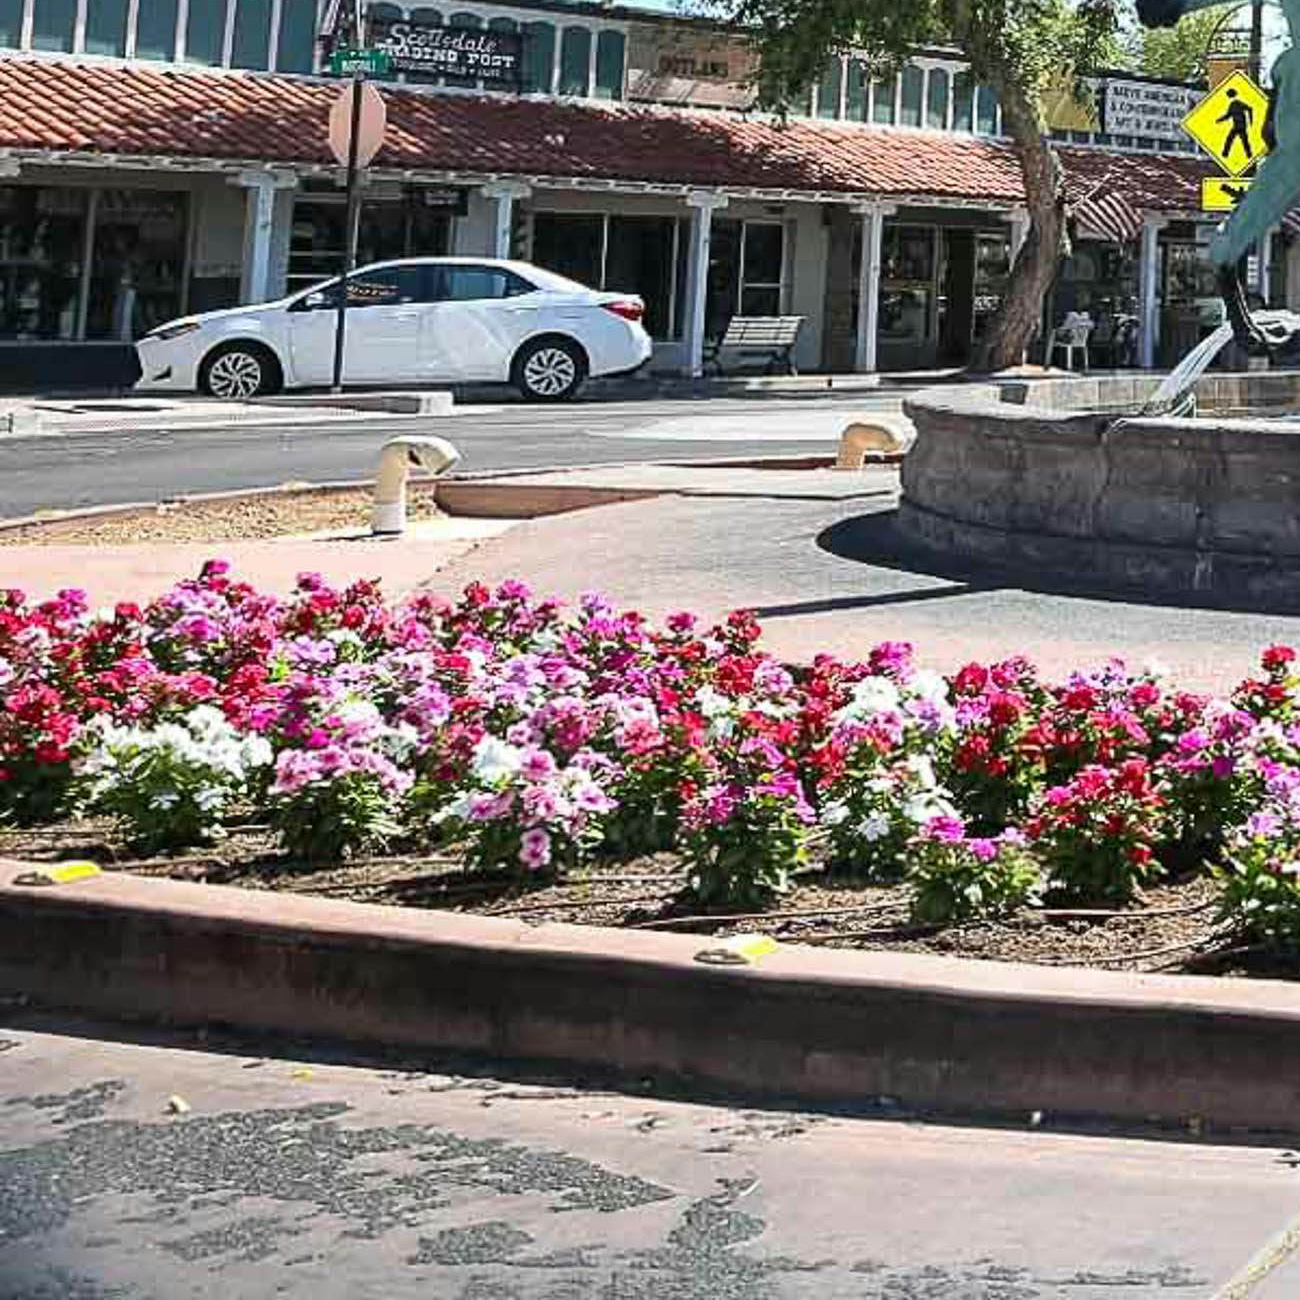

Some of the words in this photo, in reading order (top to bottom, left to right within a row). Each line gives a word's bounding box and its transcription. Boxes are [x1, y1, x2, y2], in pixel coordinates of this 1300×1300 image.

[390, 23, 497, 53] Scottsdale
[375, 42, 458, 63] TRADING
[466, 53, 515, 69] POST
